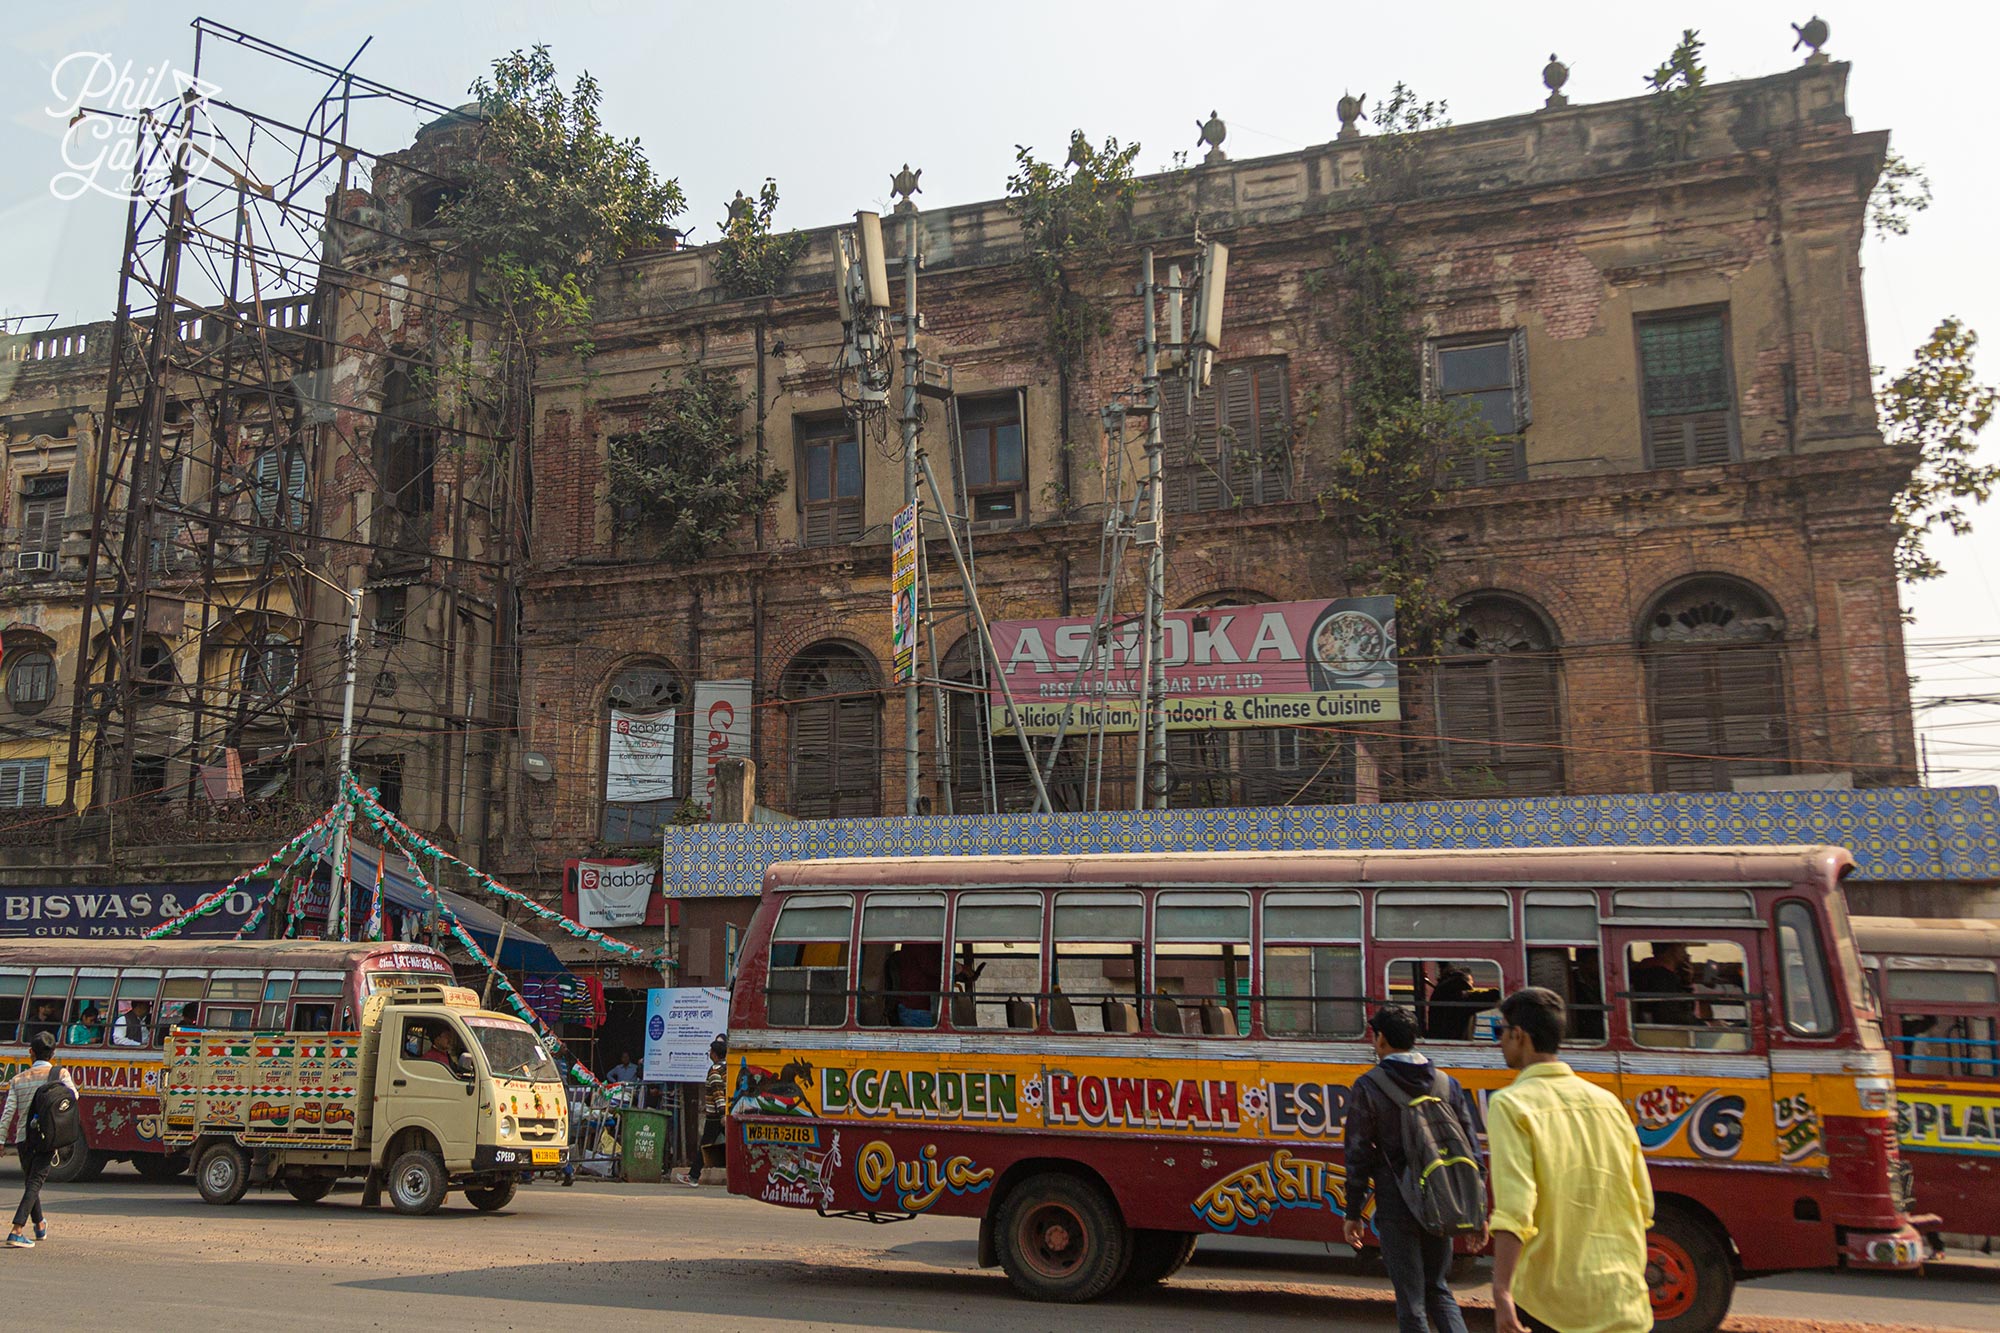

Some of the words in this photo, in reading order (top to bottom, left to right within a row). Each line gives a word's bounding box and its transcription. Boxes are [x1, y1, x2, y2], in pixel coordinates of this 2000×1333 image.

[894, 514, 902, 531] NO
[894, 535, 901, 552] NO
[1004, 612, 1302, 675] ASHOKA
[1197, 675, 1231, 691] PVT.
[1236, 673, 1262, 689] LTD
[1223, 701, 1237, 720] &
[1243, 697, 1311, 719] Chinese
[1316, 693, 1381, 716] Cuisine
[4, 892, 152, 921] BISWAS
[159, 893, 184, 918] &
[35, 926, 79, 937] GUN
[89, 925, 183, 937] MAKES
[1048, 1075, 1240, 1130] HOWRAH
[1690, 1094, 1746, 1156] 6
[496, 1151, 515, 1162] SPEED
[857, 1140, 995, 1211] Puja
[761, 1184, 780, 1202] Jai
